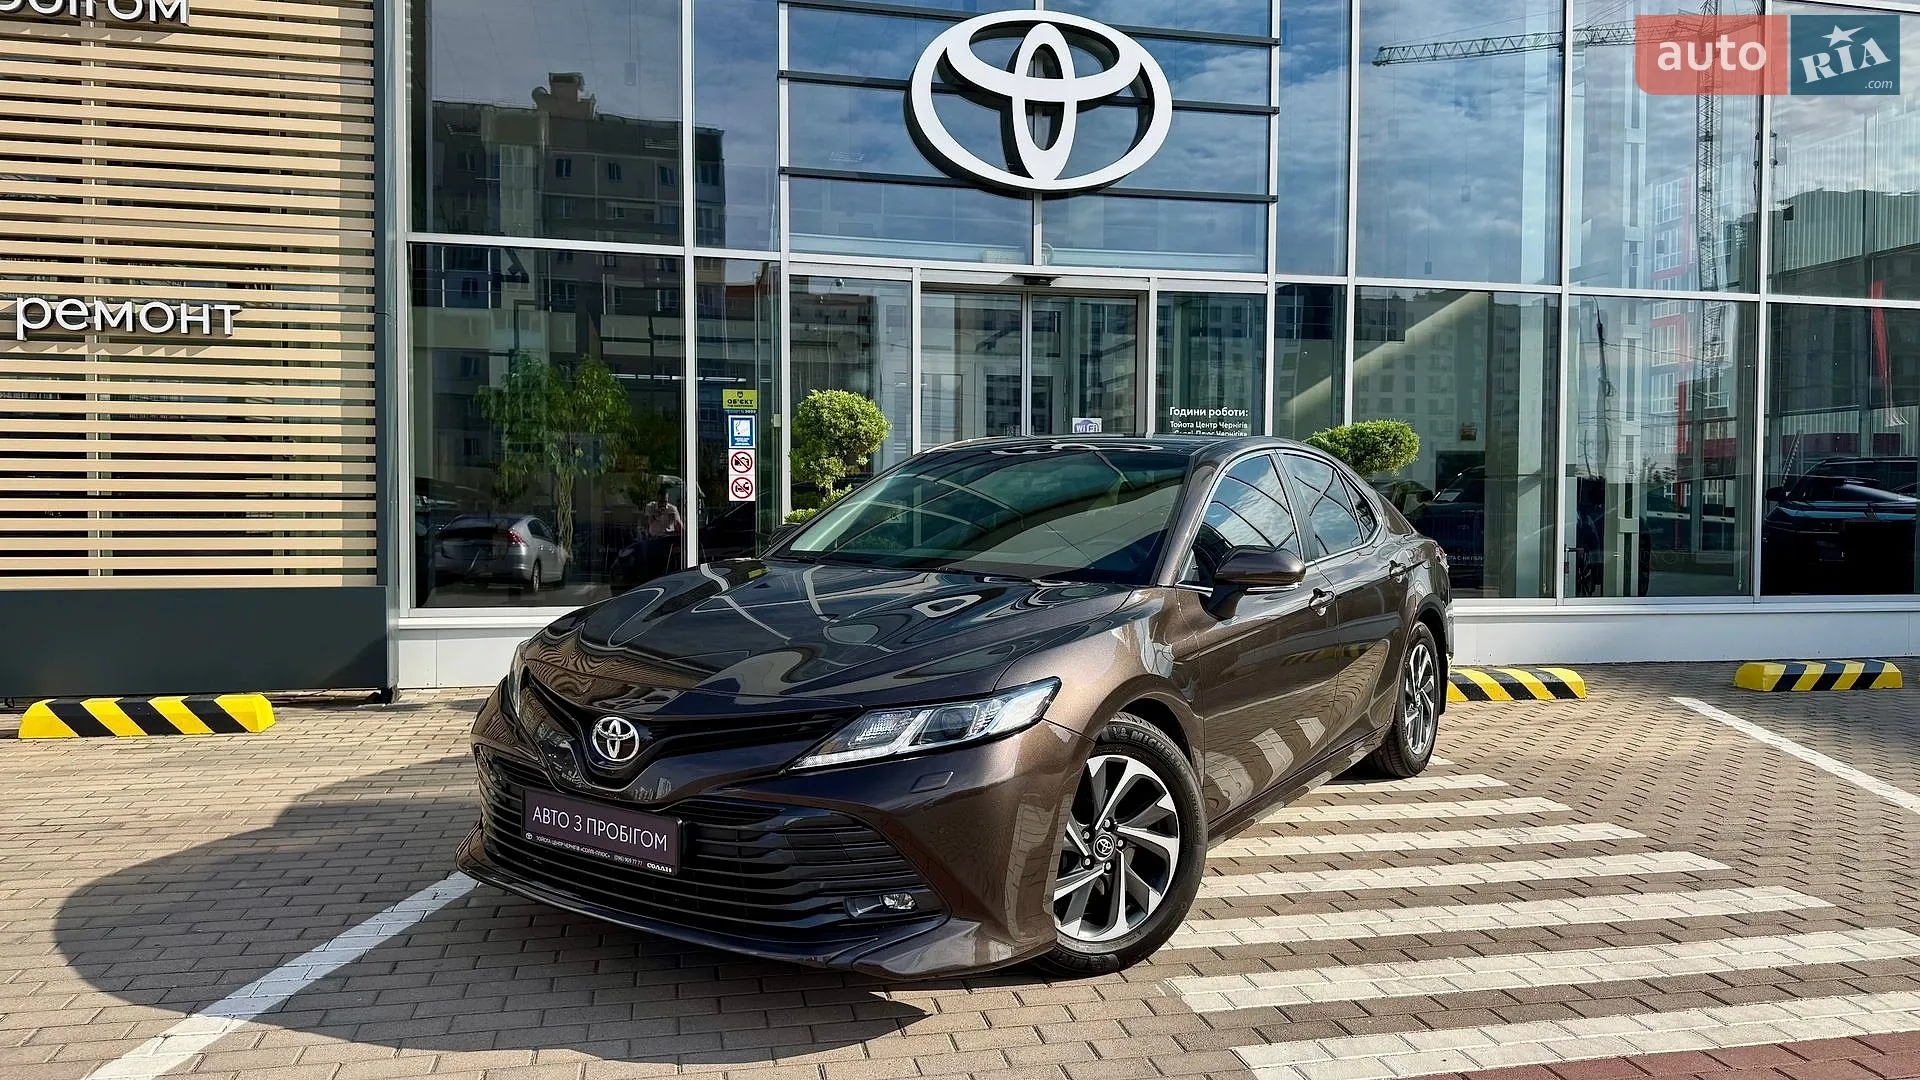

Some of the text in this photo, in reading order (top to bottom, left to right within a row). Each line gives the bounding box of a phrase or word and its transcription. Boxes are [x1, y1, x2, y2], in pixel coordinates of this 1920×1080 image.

[16, 297, 241, 341] ремонт
[1169, 406, 1249, 418] Години роботи:
[1169, 420, 1194, 429] Тойота
[1195, 421, 1218, 430] Центр
[532, 805, 570, 828] АВТО
[586, 818, 668, 852] ПРОБІГОМ
